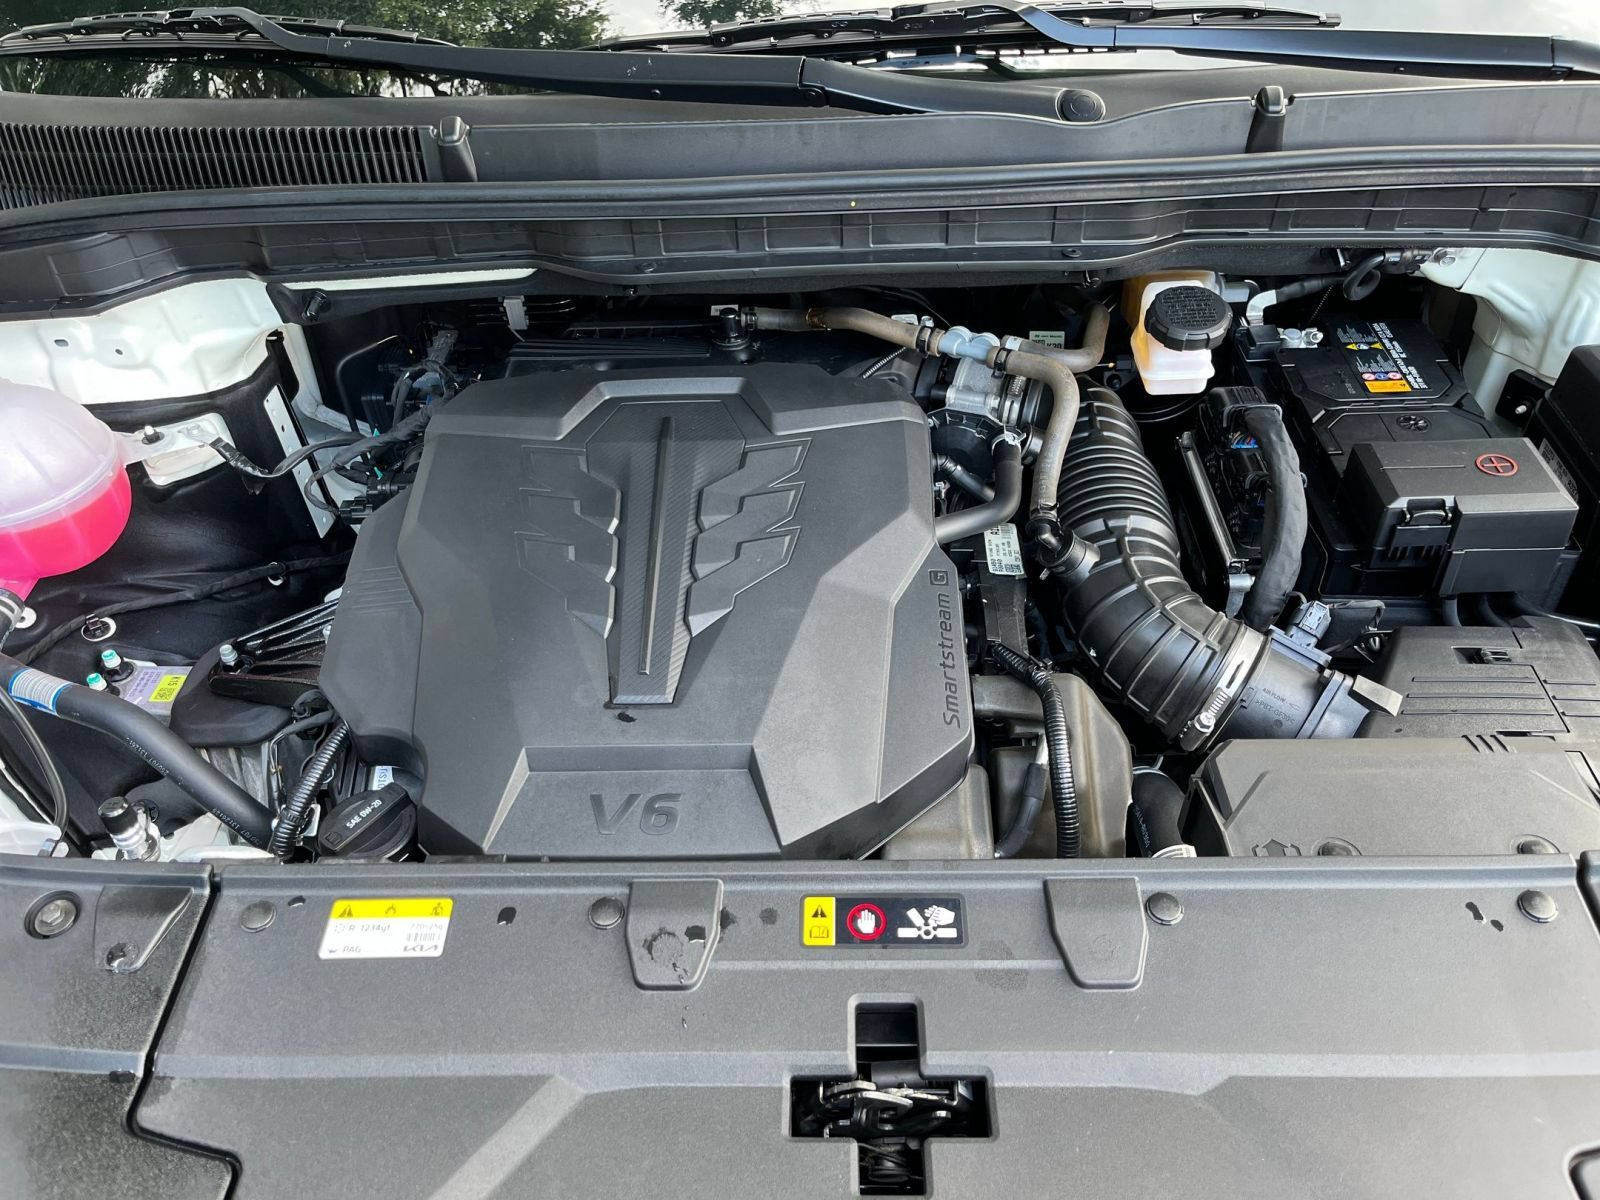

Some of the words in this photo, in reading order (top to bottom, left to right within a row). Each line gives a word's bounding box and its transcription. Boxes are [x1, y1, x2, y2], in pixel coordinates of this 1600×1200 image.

[937, 592, 961, 729] Smartstream
[346, 815, 362, 829] SAE
[359, 799, 382, 818] 0W-20
[589, 793, 682, 835] V6
[342, 945, 362, 953] PAG
[402, 944, 439, 952] KIA
